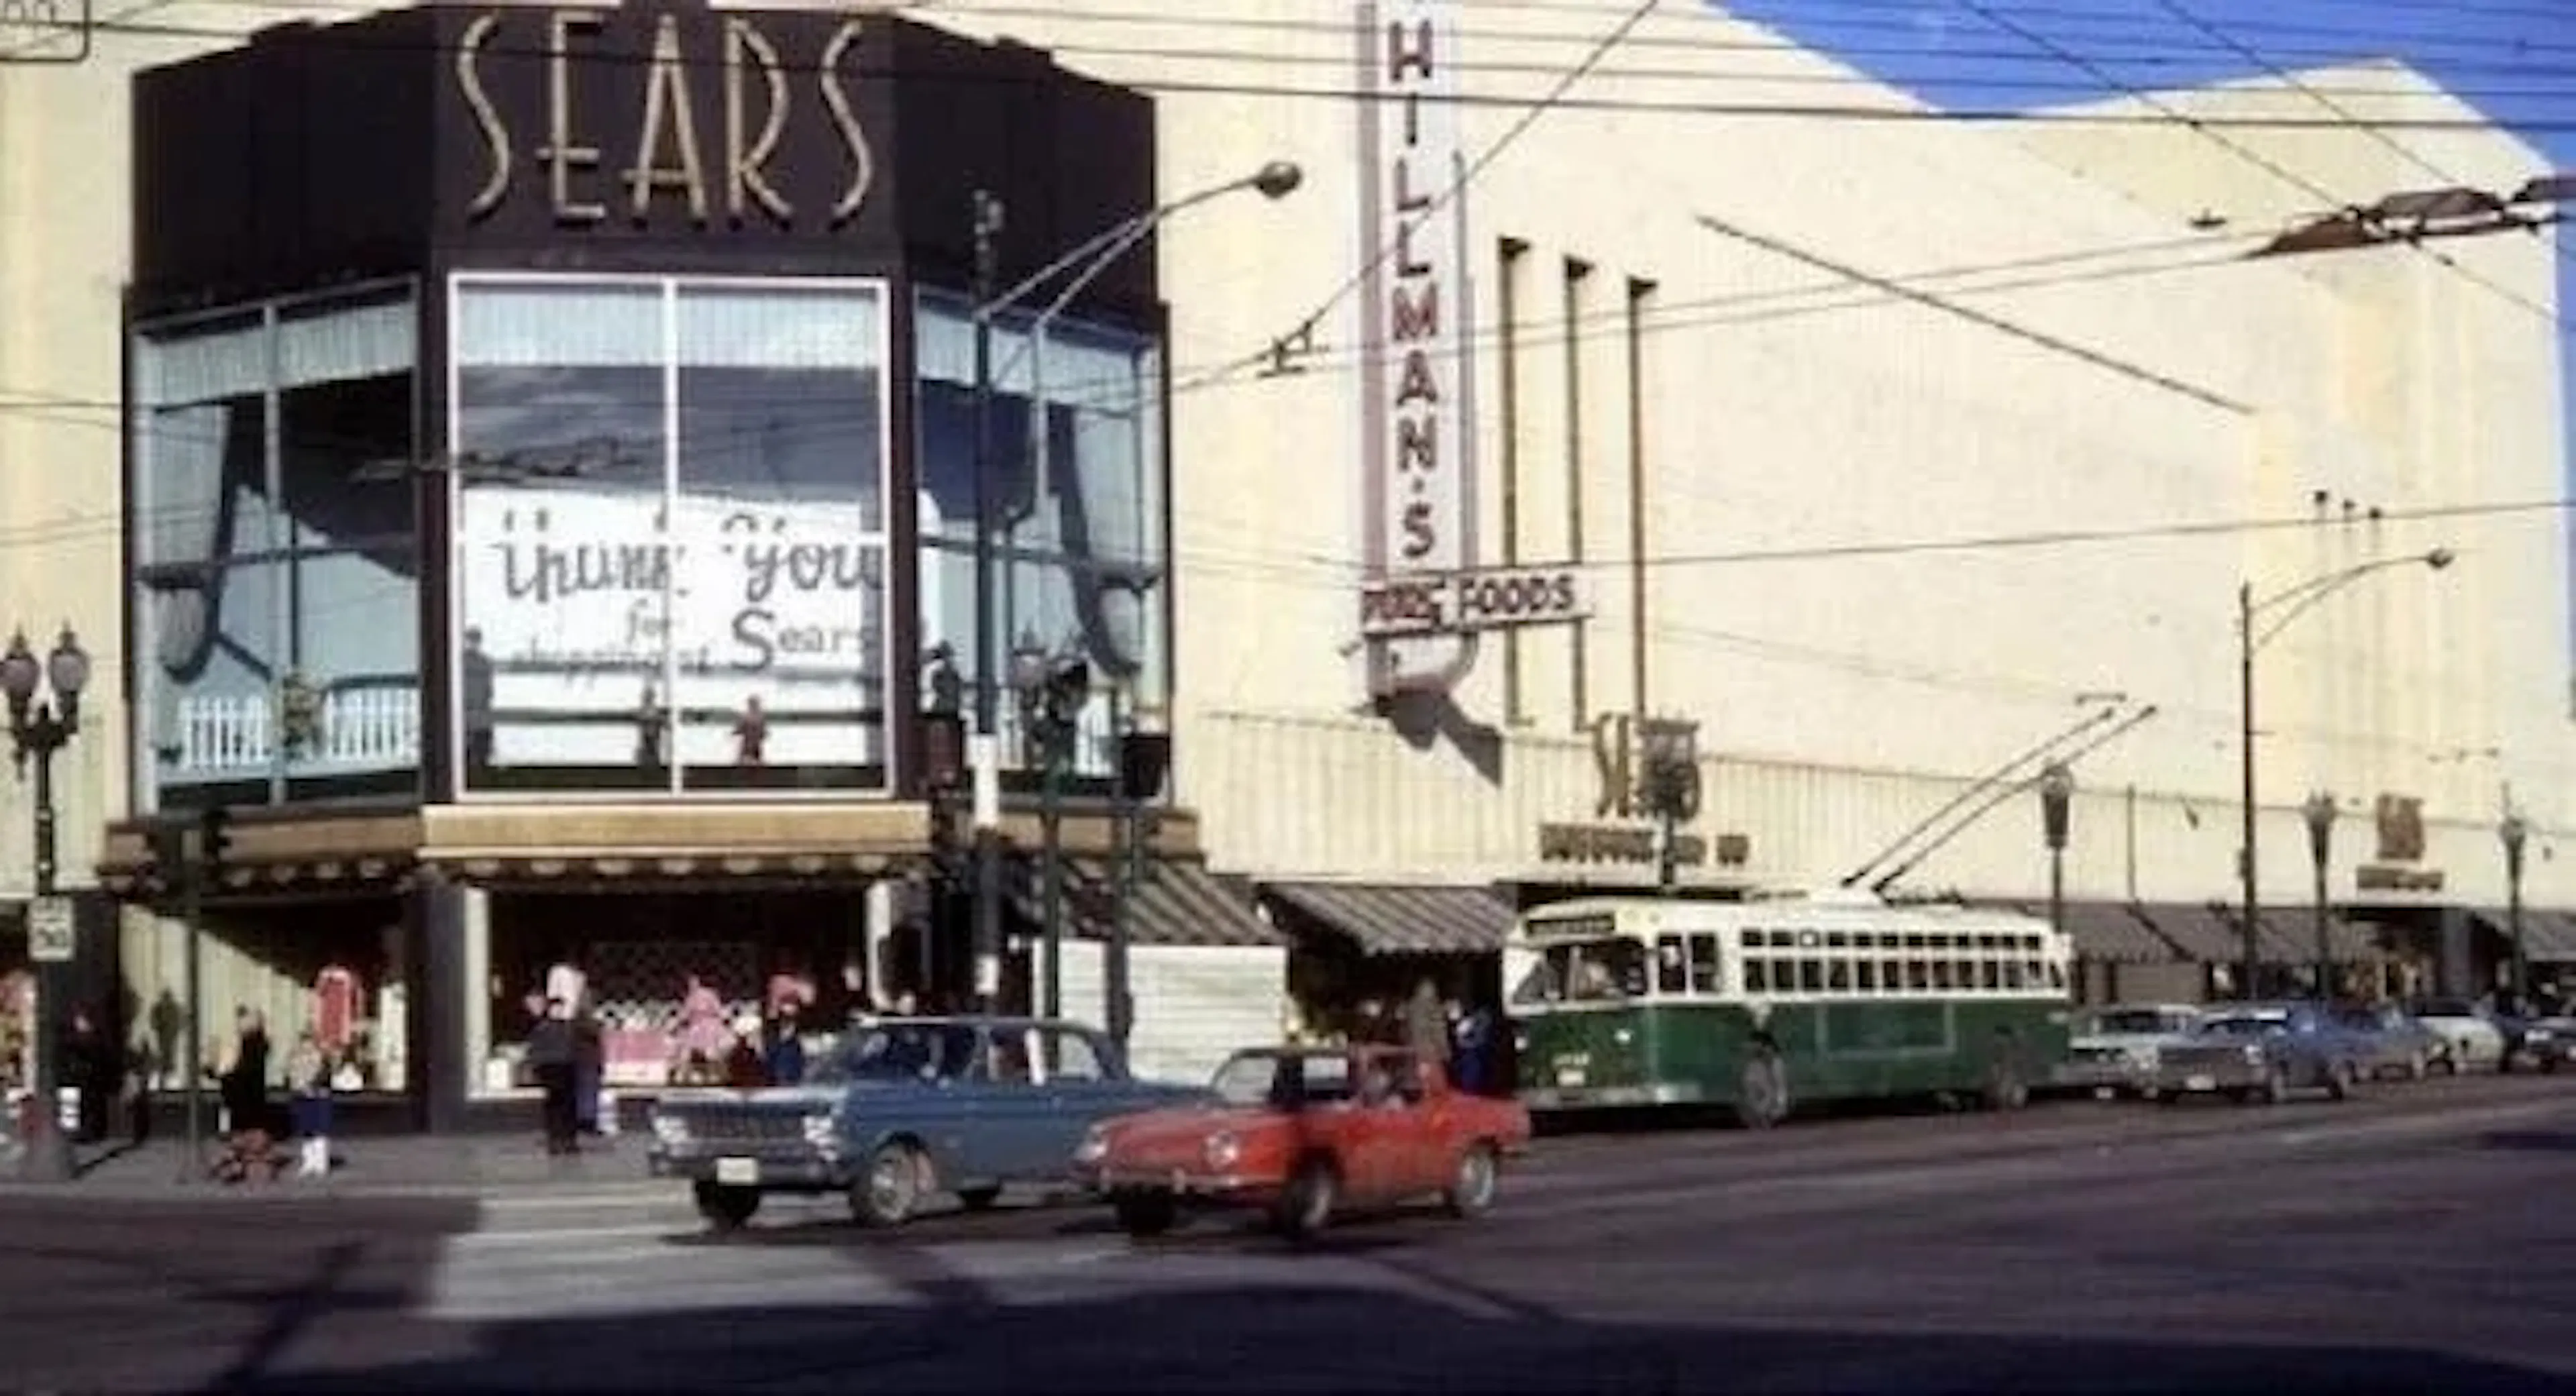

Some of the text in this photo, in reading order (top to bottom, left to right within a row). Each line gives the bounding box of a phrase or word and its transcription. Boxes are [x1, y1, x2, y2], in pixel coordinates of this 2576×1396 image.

[456, 7, 872, 223] SEARS
[1389, 18, 1438, 558] HILLMAN'S
[1460, 574, 1574, 624] FOODS
